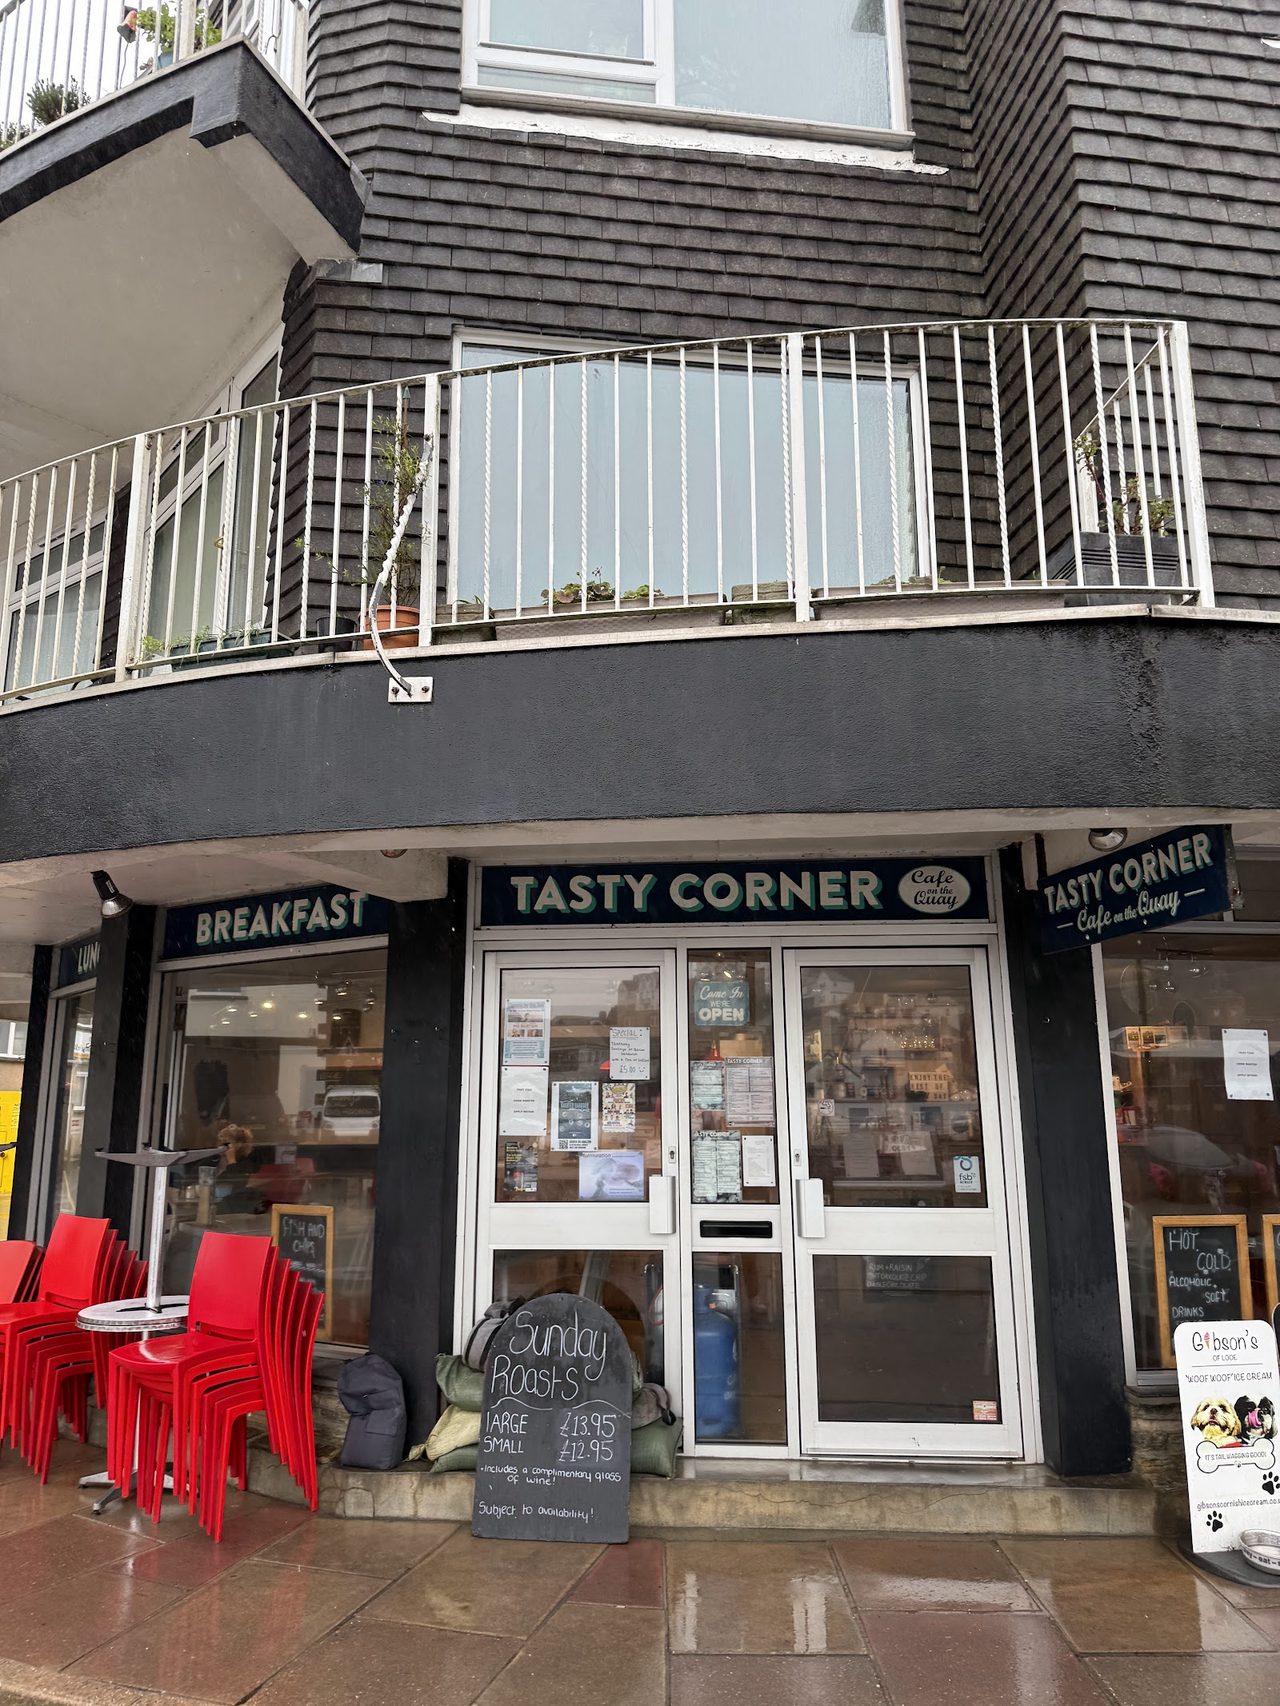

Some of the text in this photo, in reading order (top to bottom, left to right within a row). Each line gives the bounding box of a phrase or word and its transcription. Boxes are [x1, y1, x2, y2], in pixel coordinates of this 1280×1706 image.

[911, 870, 954, 887] Cafe
[1044, 832, 1213, 914] TASTY CORNER
[510, 870, 883, 913] TASTY CORNER
[914, 890, 958, 909] Quay
[940, 886, 954, 895] the
[195, 892, 369, 946] BREAKFAST
[1077, 890, 1181, 934] Cafe on the Quay
[77, 941, 101, 974] LUN
[700, 985, 744, 1000] Come In
[698, 1007, 745, 1021] OPEN
[1172, 1306, 1205, 1318] DRINKS
[509, 1309, 607, 1380] Sunday
[491, 1354, 579, 1401] Roasts
[1234, 1373, 1245, 1381] ICE
[1246, 1372, 1272, 1381] CREAM
[559, 1412, 617, 1438] £13.95
[483, 1435, 615, 1462] SMALL £12.95
[507, 1475, 556, 1486] of wine!
[532, 1467, 592, 1482] complimentary
[478, 1500, 516, 1519] Subject
[522, 1504, 532, 1515] to
